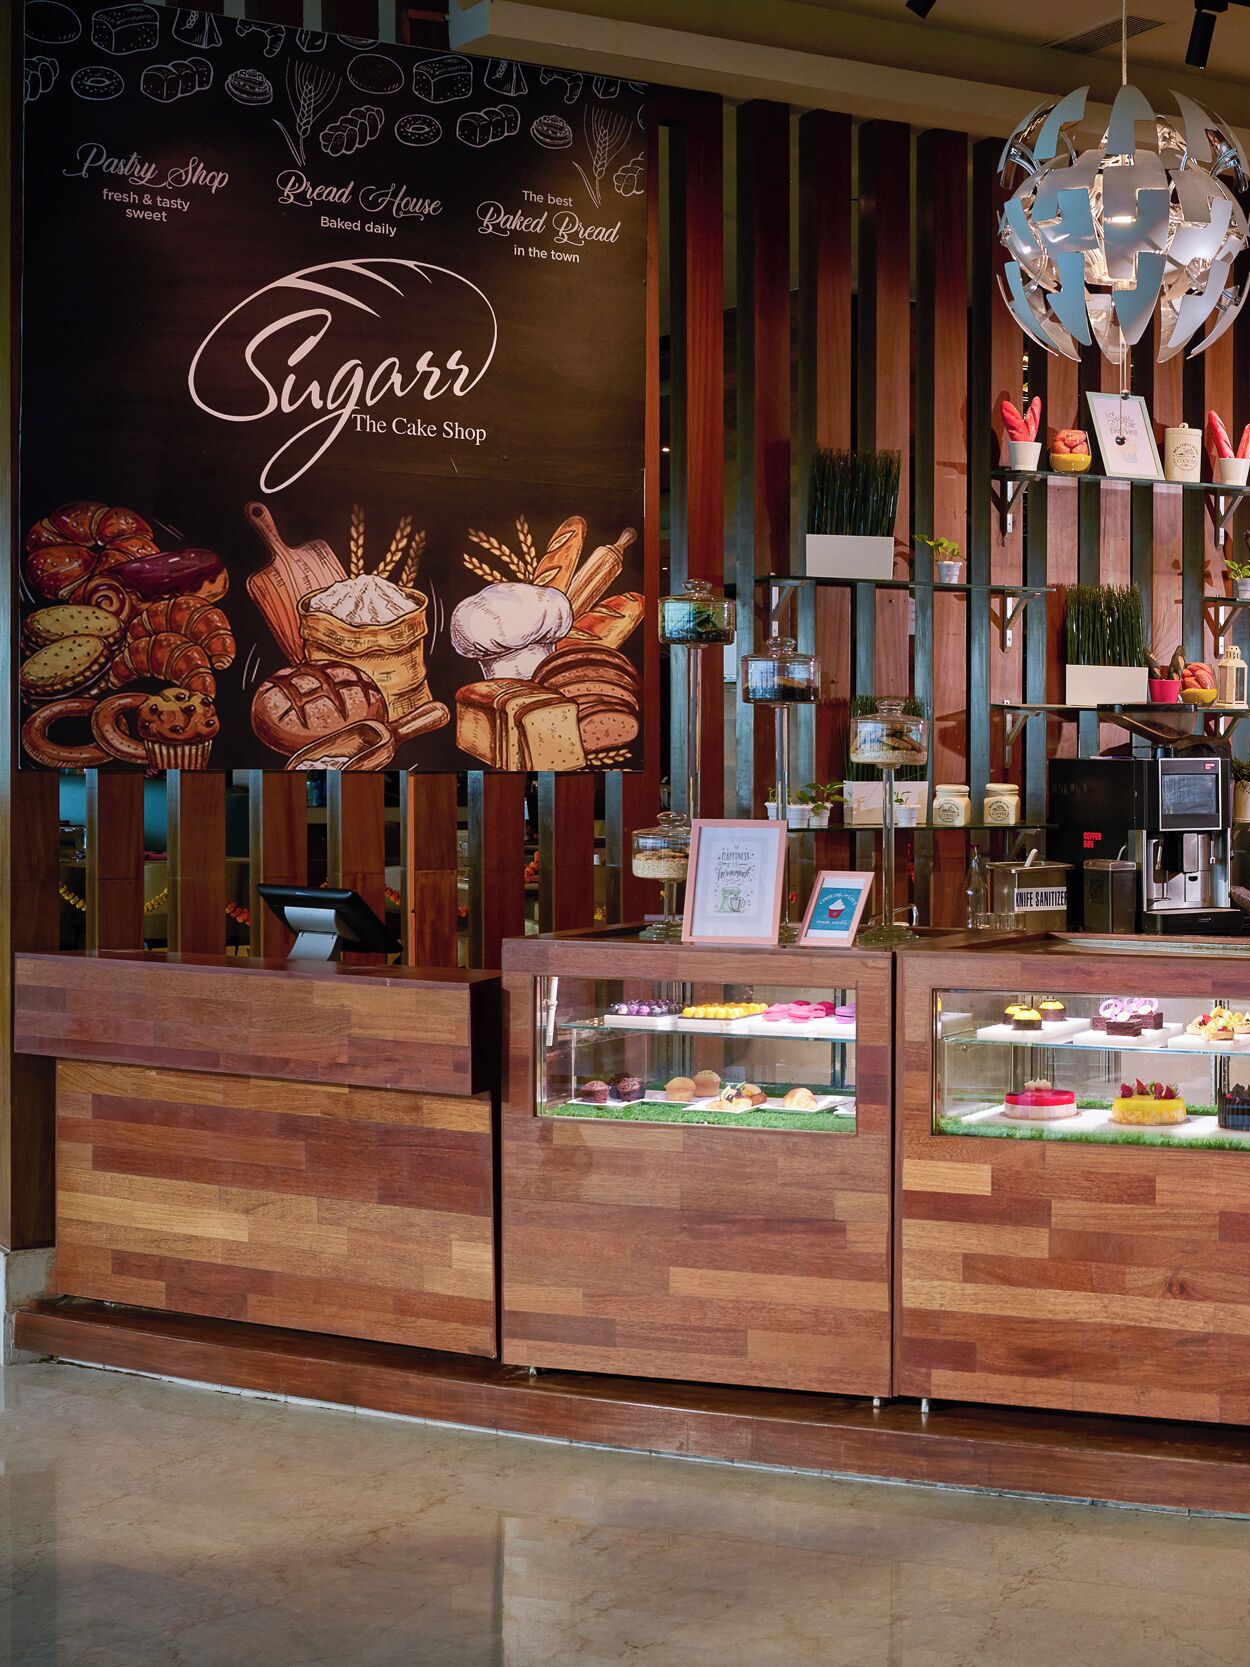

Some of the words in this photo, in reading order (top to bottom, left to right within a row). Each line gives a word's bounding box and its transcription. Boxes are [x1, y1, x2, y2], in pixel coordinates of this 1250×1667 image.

[63, 143, 166, 187] Pastry
[166, 157, 229, 194] Shop
[102, 188, 139, 205] fresh
[142, 193, 153, 206] &
[156, 195, 190, 212] tasty
[276, 170, 355, 207] Bread
[359, 183, 444, 221] House
[522, 190, 544, 203] The
[547, 193, 573, 207] best
[125, 207, 168, 222] sweet
[320, 216, 361, 232] Baked
[365, 221, 397, 237] daily
[476, 201, 548, 237] Baked
[552, 211, 621, 246] Bread
[513, 244, 525, 256] in
[528, 247, 548, 260] the
[551, 249, 580, 263] town
[188, 275, 497, 493] Sugarr
[351, 414, 387, 433] The
[392, 416, 437, 438] Cake
[442, 422, 487, 446] Shop
[1016, 892, 1033, 907] KNIFE
